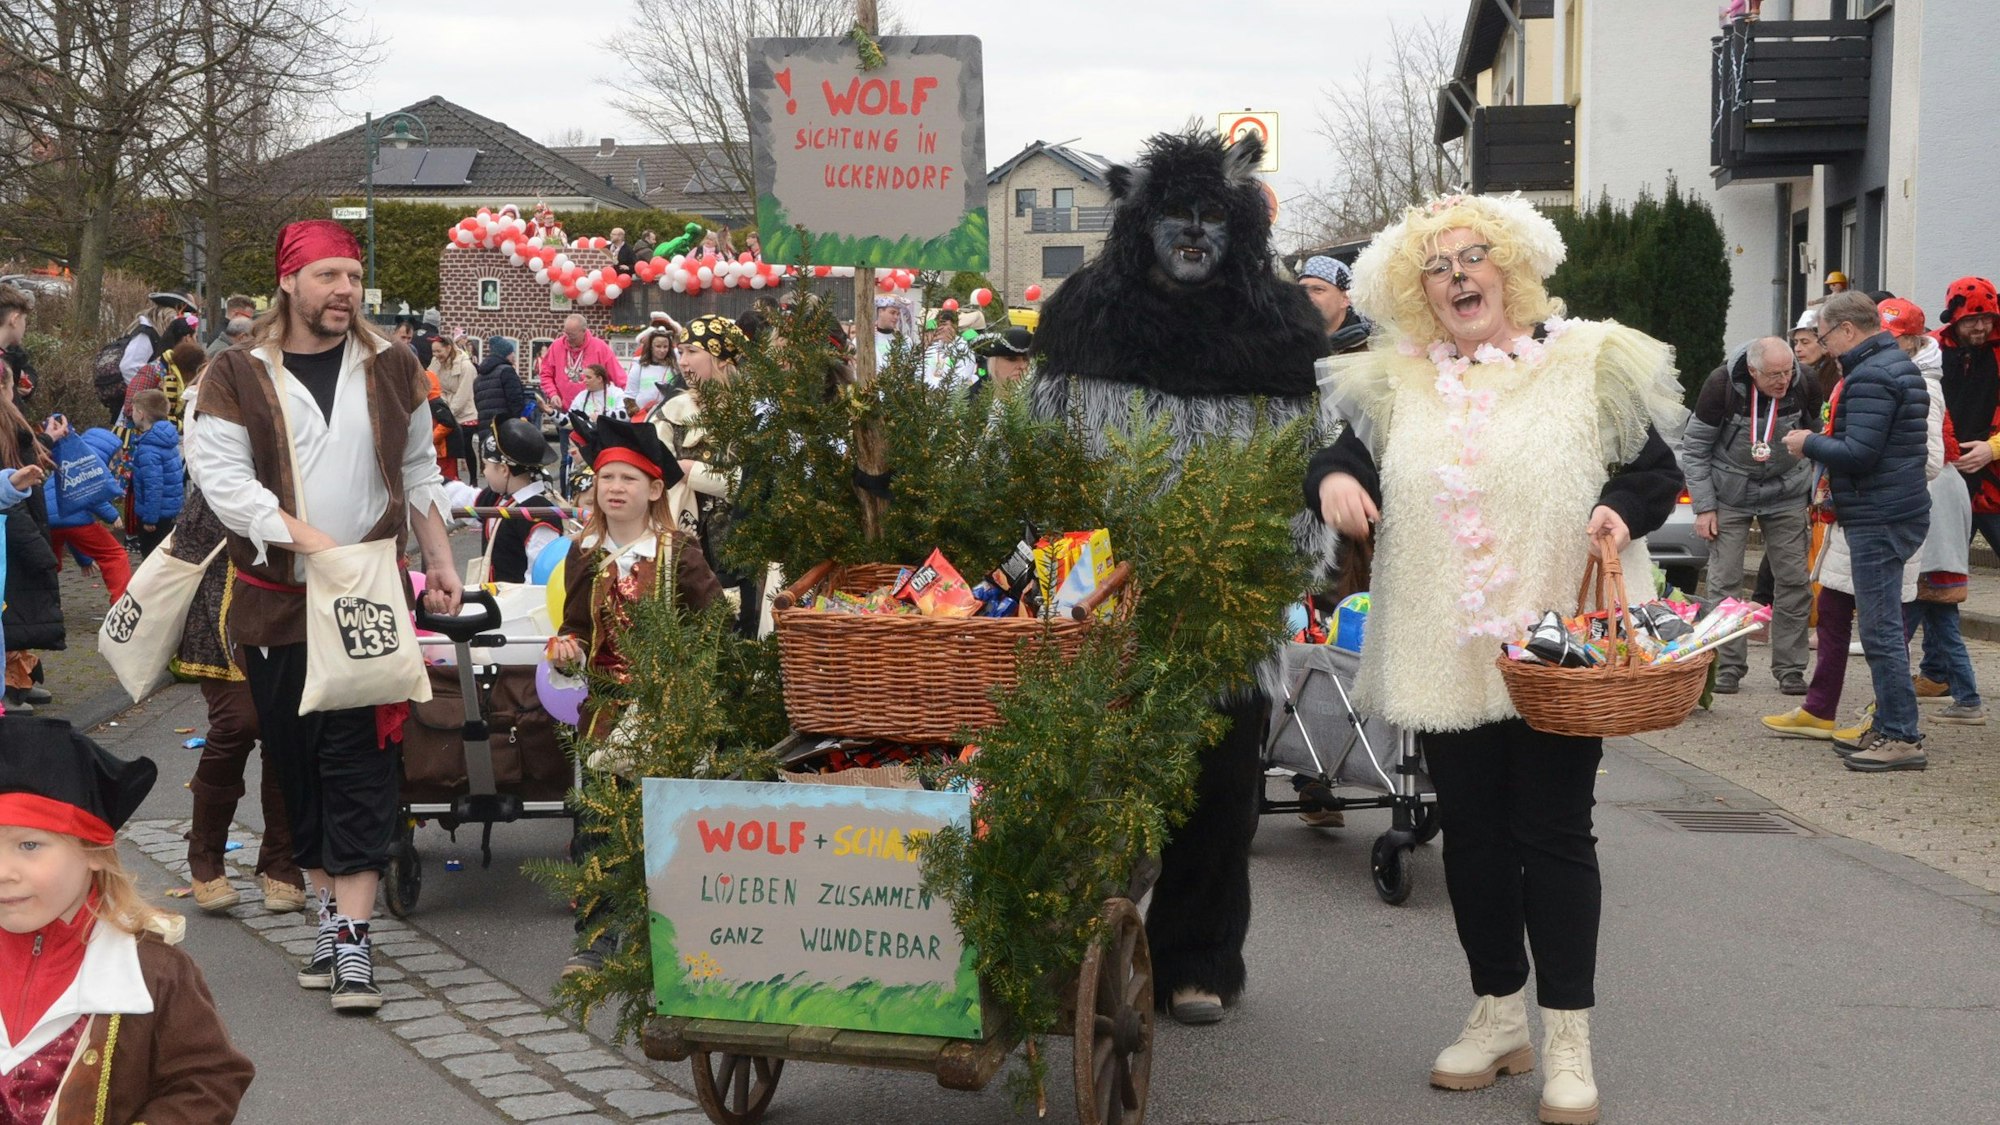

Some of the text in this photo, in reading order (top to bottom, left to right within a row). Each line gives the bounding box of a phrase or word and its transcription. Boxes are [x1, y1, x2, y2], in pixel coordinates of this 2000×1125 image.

[774, 67, 938, 116] ! WOLF
[824, 164, 954, 190] UCKENDORF
[62, 467, 104, 491] Apotheke
[340, 597, 358, 608] DIE
[348, 629, 385, 656] 13
[697, 819, 807, 855] WOLF
[813, 833, 828, 850] +
[817, 882, 934, 911] ZUSAMMEN
[710, 927, 941, 961] GANZ WUNDERBAR
